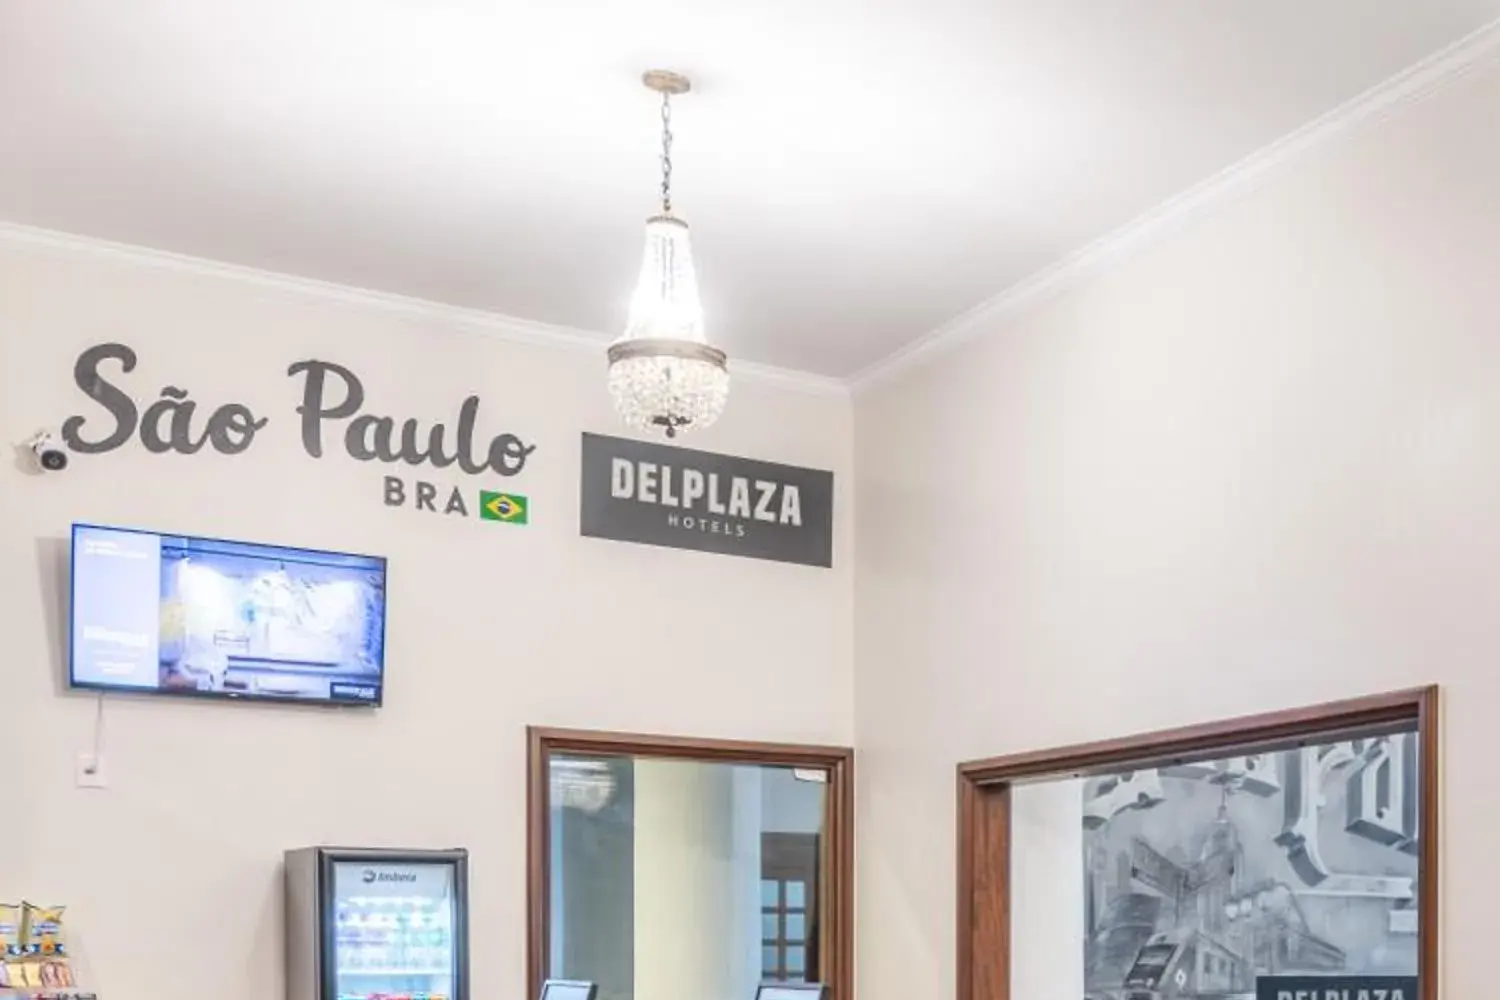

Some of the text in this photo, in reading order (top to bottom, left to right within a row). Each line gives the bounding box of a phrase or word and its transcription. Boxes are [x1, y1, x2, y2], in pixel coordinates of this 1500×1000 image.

[61, 342, 536, 476] São Paulo
[383, 475, 469, 517] BRA
[611, 456, 802, 527] DELPLAZA
[668, 513, 746, 537] HOTELS
